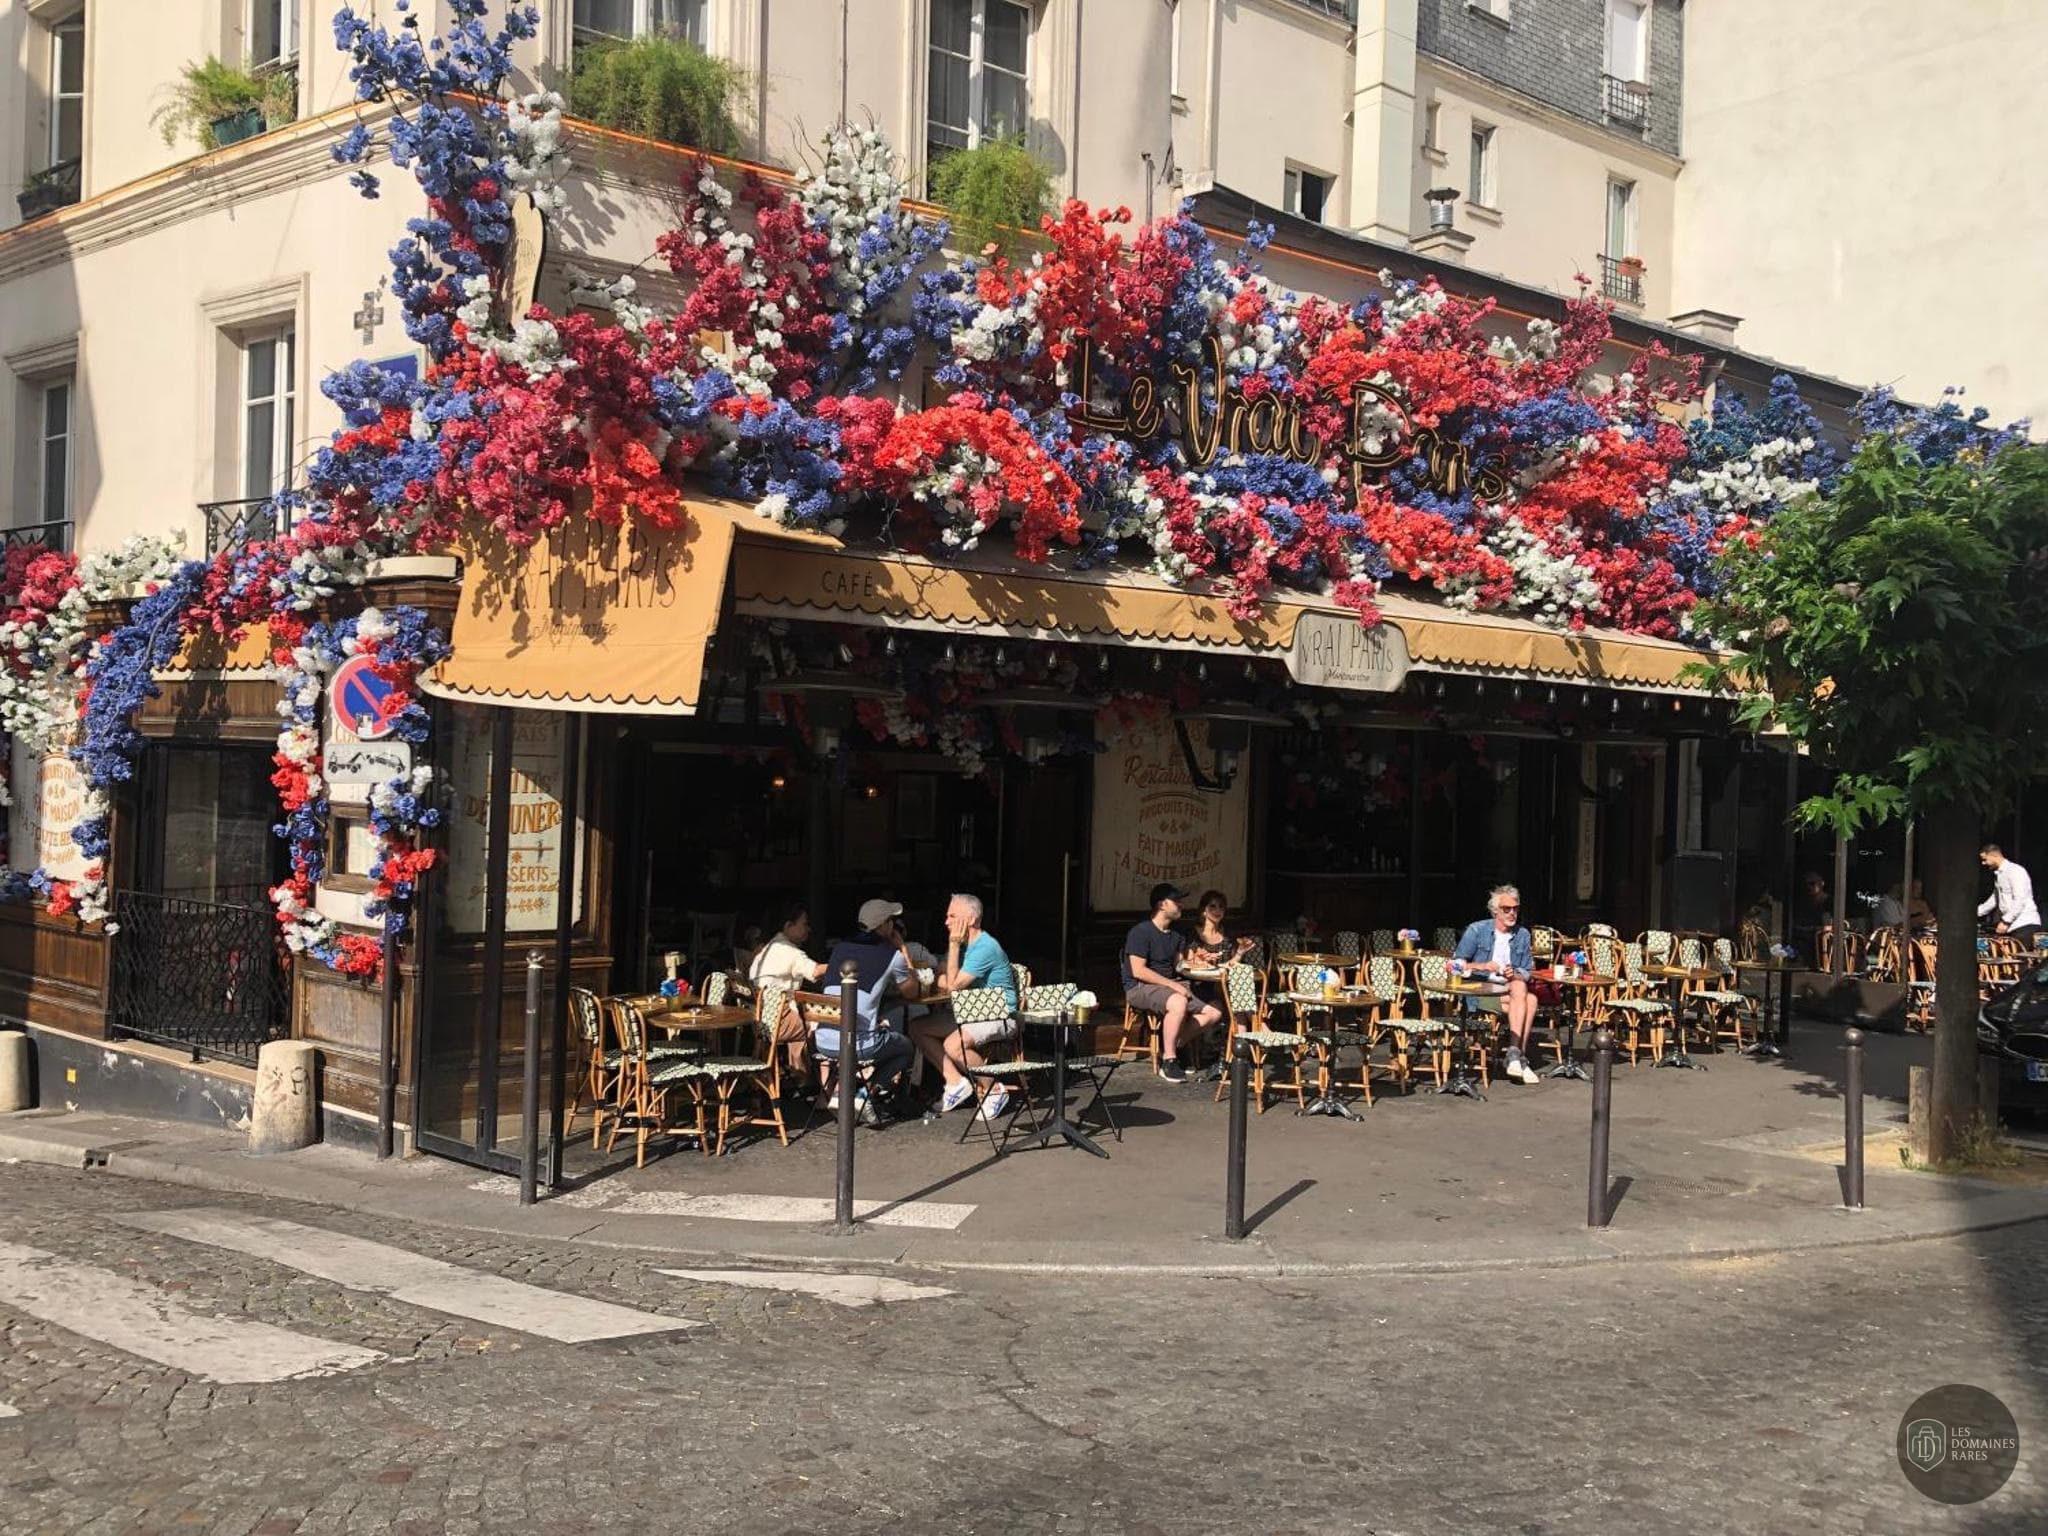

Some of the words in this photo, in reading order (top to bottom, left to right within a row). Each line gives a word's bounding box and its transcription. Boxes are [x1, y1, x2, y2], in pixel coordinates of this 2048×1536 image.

[1067, 336, 1163, 439] Le
[1172, 336, 1322, 468] Vrai
[821, 568, 873, 597] CAFÉ
[1301, 622, 1341, 667] VRAI
[1138, 833, 1164, 856] FAIT
[1135, 857, 1178, 879] TOUTE
